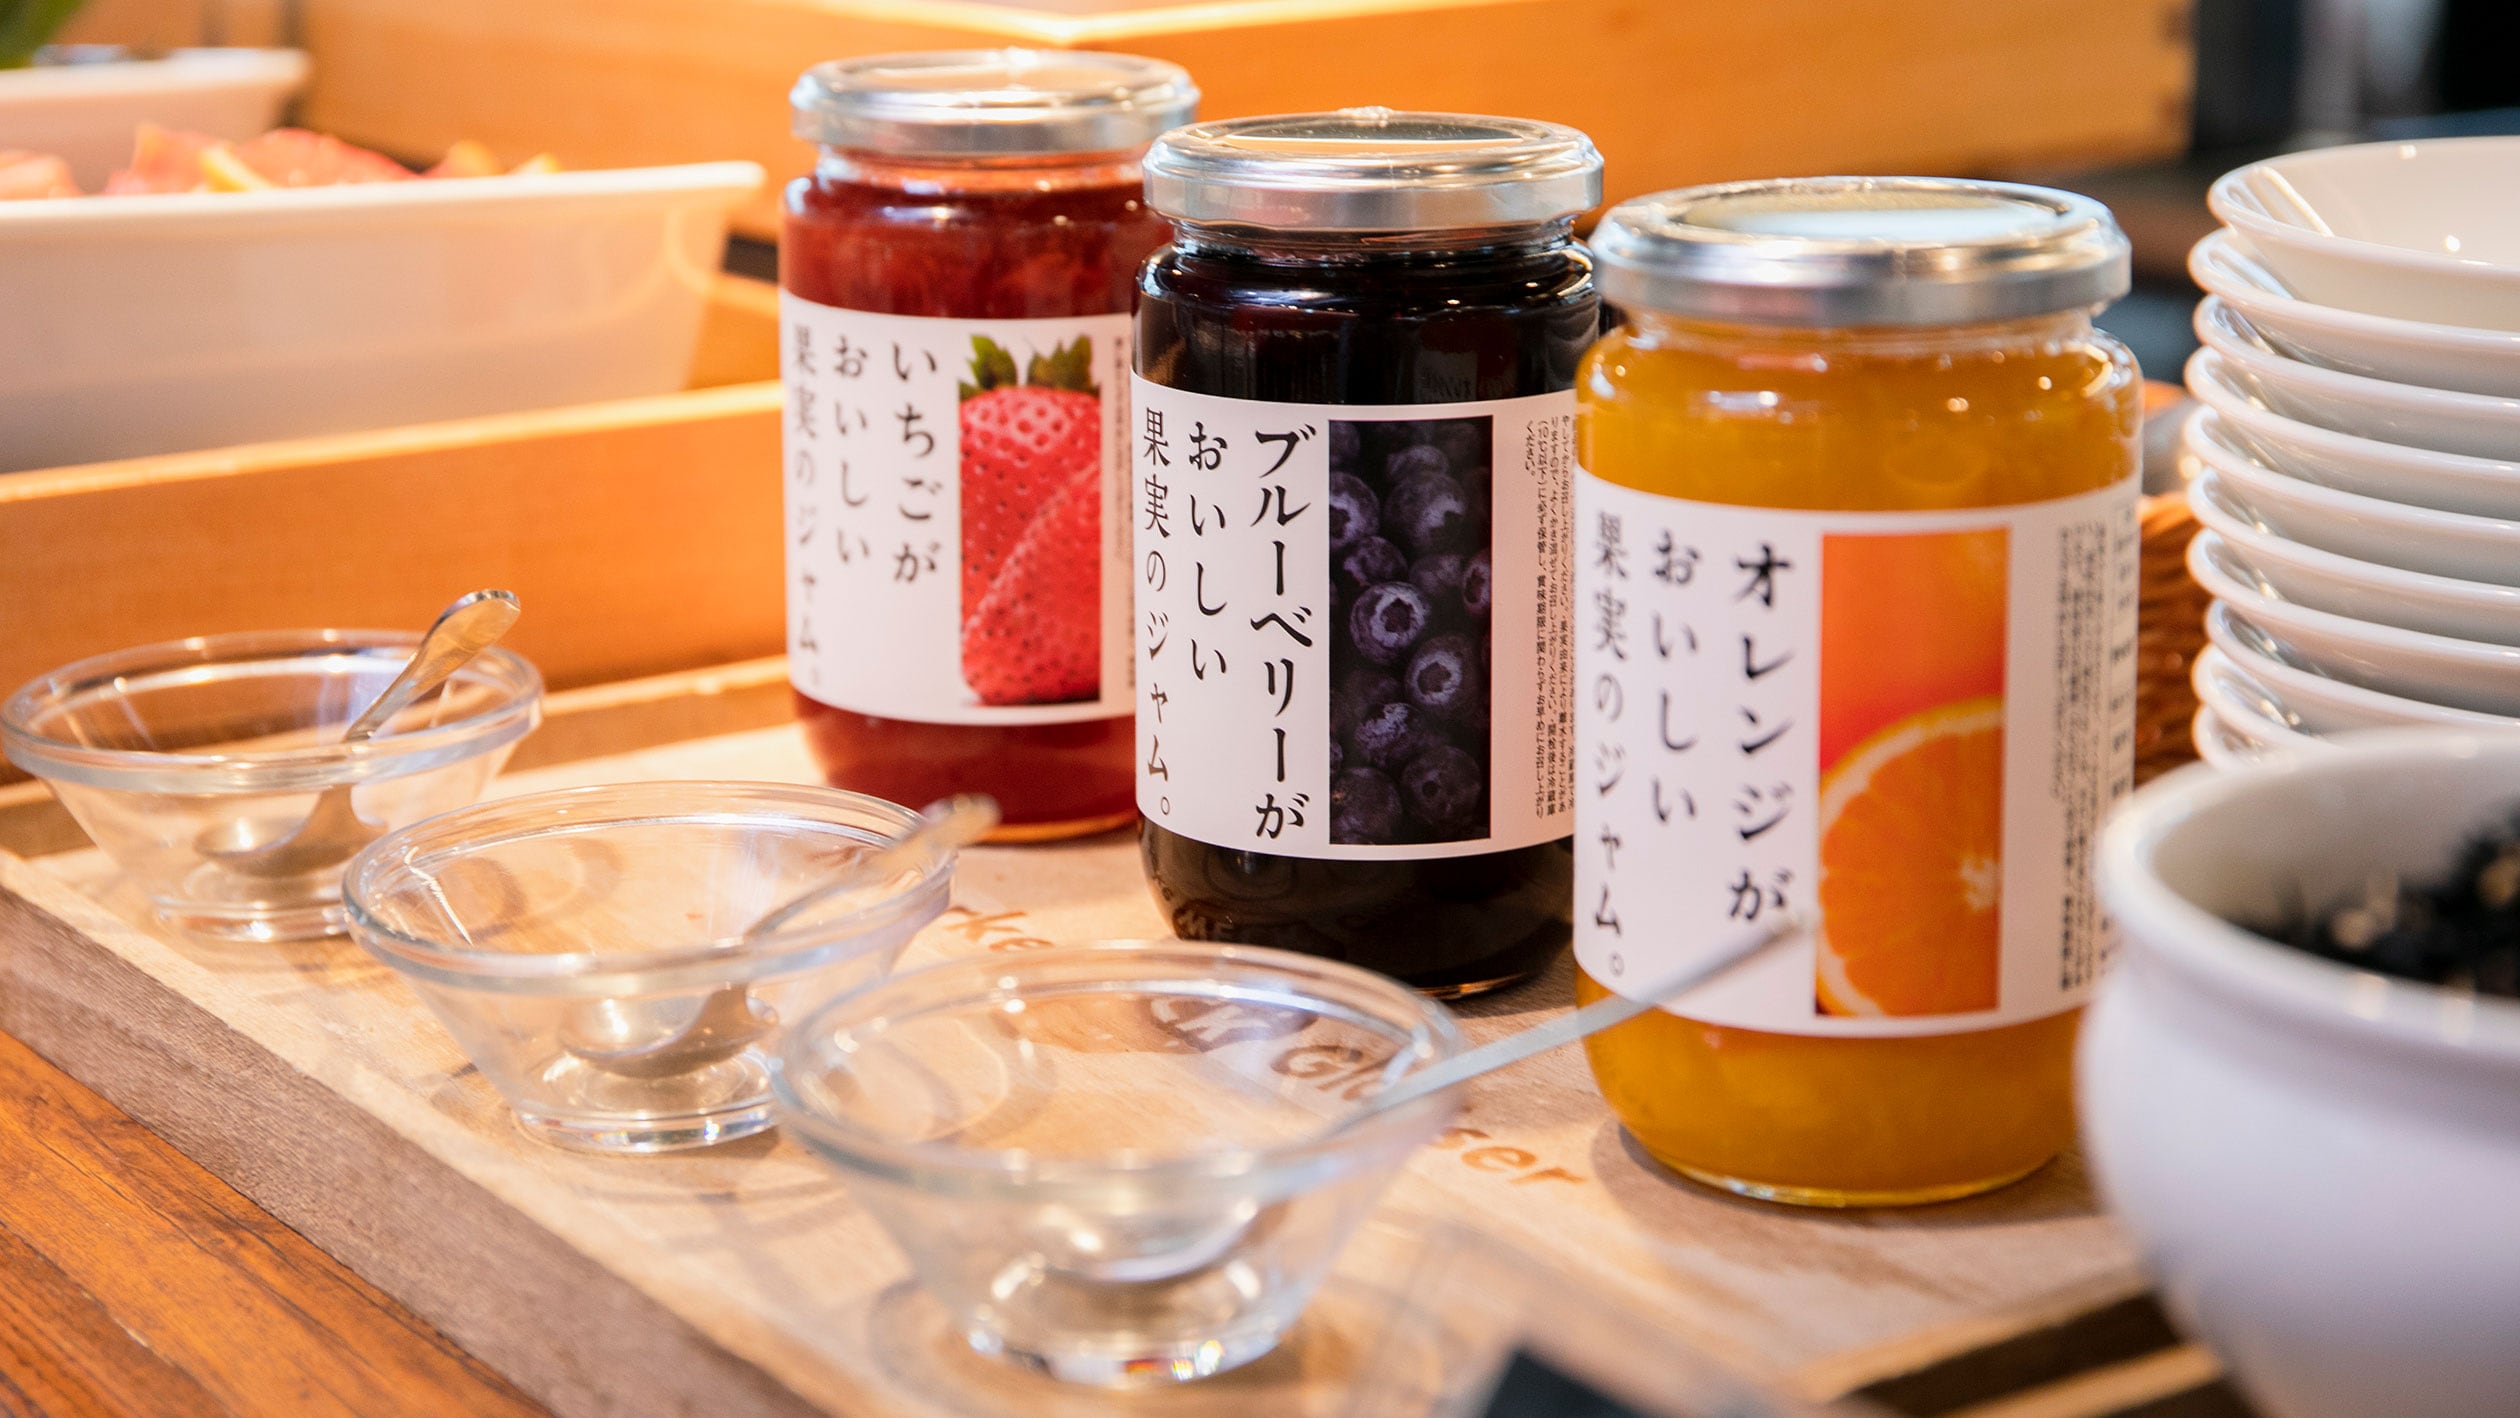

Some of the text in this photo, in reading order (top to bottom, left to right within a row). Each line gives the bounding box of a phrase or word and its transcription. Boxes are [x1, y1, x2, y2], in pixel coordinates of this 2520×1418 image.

[834, 335, 869, 565] おいしい
[893, 341, 943, 583] いちごが
[1143, 406, 1171, 816] 果実のジャム。
[1188, 421, 1228, 681] おいしい
[1249, 423, 1317, 839] ブルーベリーが
[1594, 511, 1628, 977] 果実のジャム。
[1652, 528, 1701, 823] おいしい
[1728, 542, 1795, 921] オレンジが
